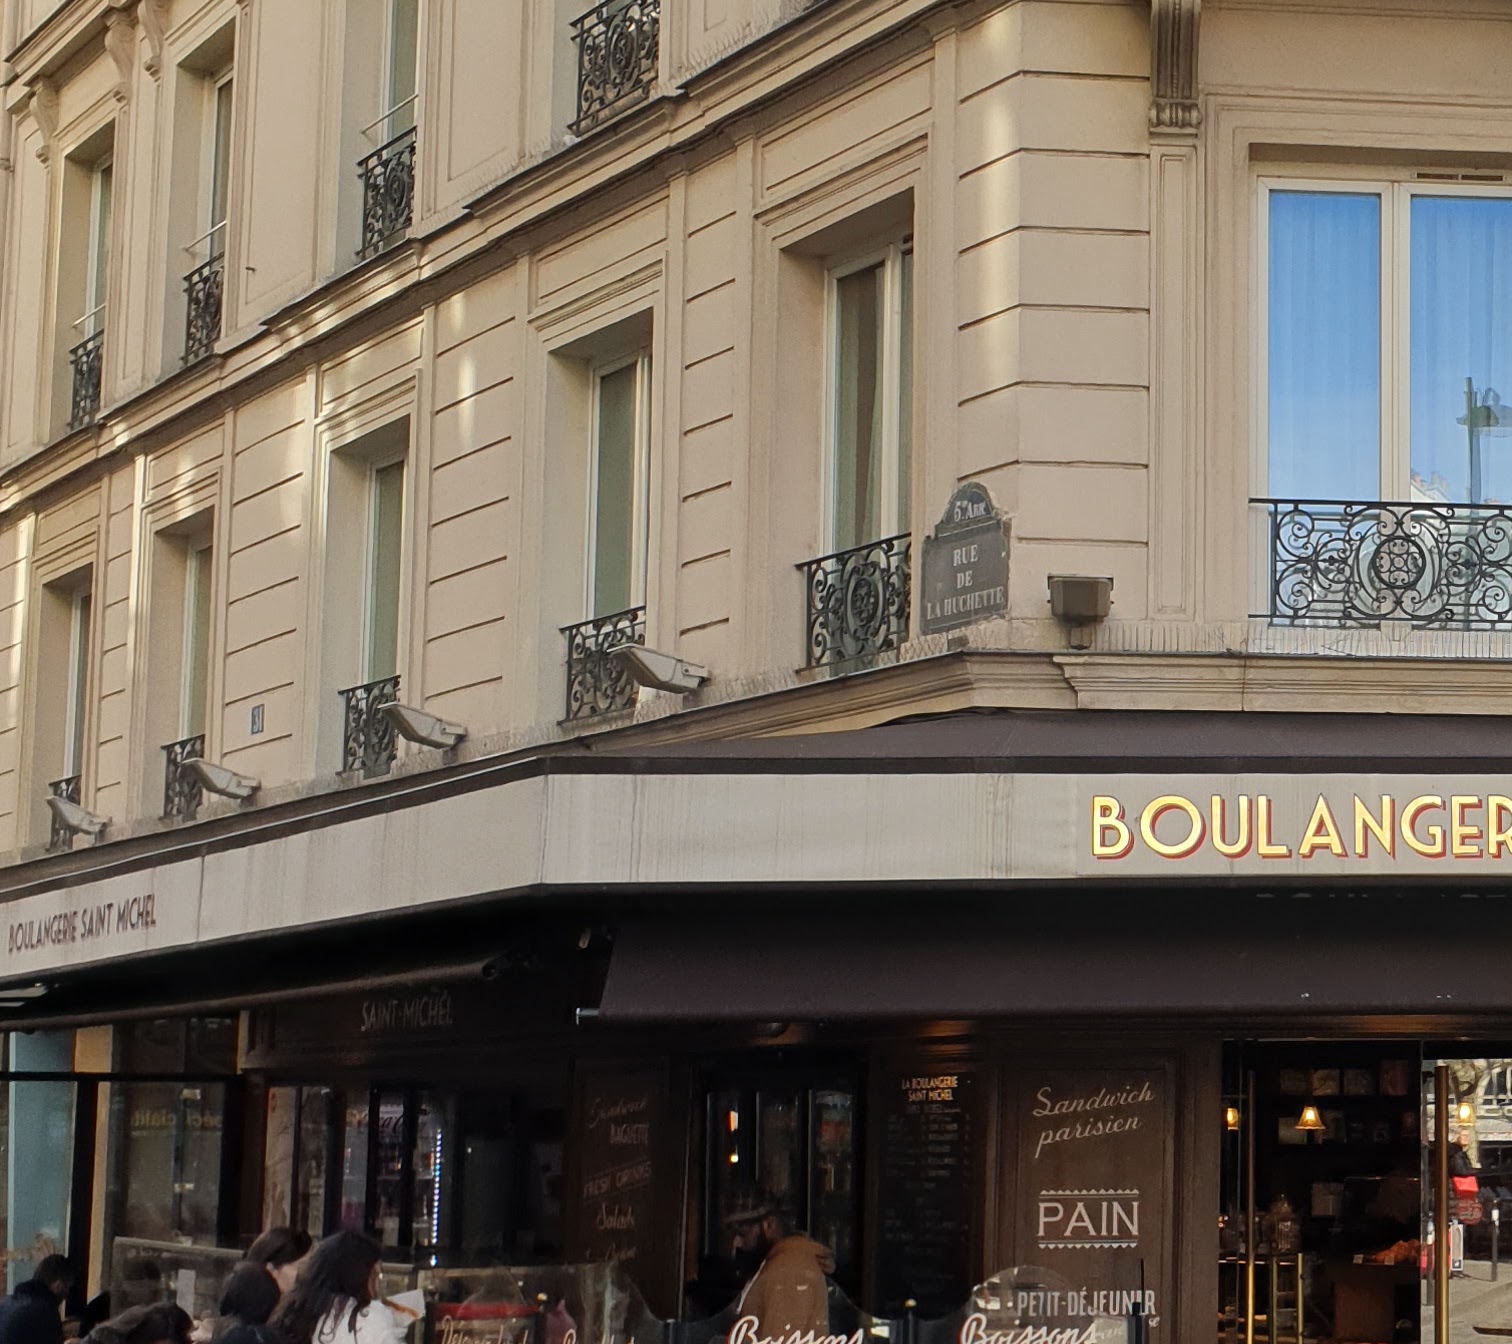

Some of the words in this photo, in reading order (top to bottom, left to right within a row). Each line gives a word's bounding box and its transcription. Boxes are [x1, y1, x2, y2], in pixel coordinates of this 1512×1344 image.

[953, 544, 979, 567] RUE
[956, 570, 973, 589] DE
[927, 602, 941, 620] LA
[944, 586, 1005, 616] HUCHETTE
[8, 910, 78, 954] BOULANGERIE
[80, 902, 114, 939] SAINT
[116, 894, 157, 934] MICHEL
[1033, 1082, 1155, 1117] Sandwich
[1035, 1112, 1142, 1159] parisien
[1037, 1201, 1140, 1238] PAIN
